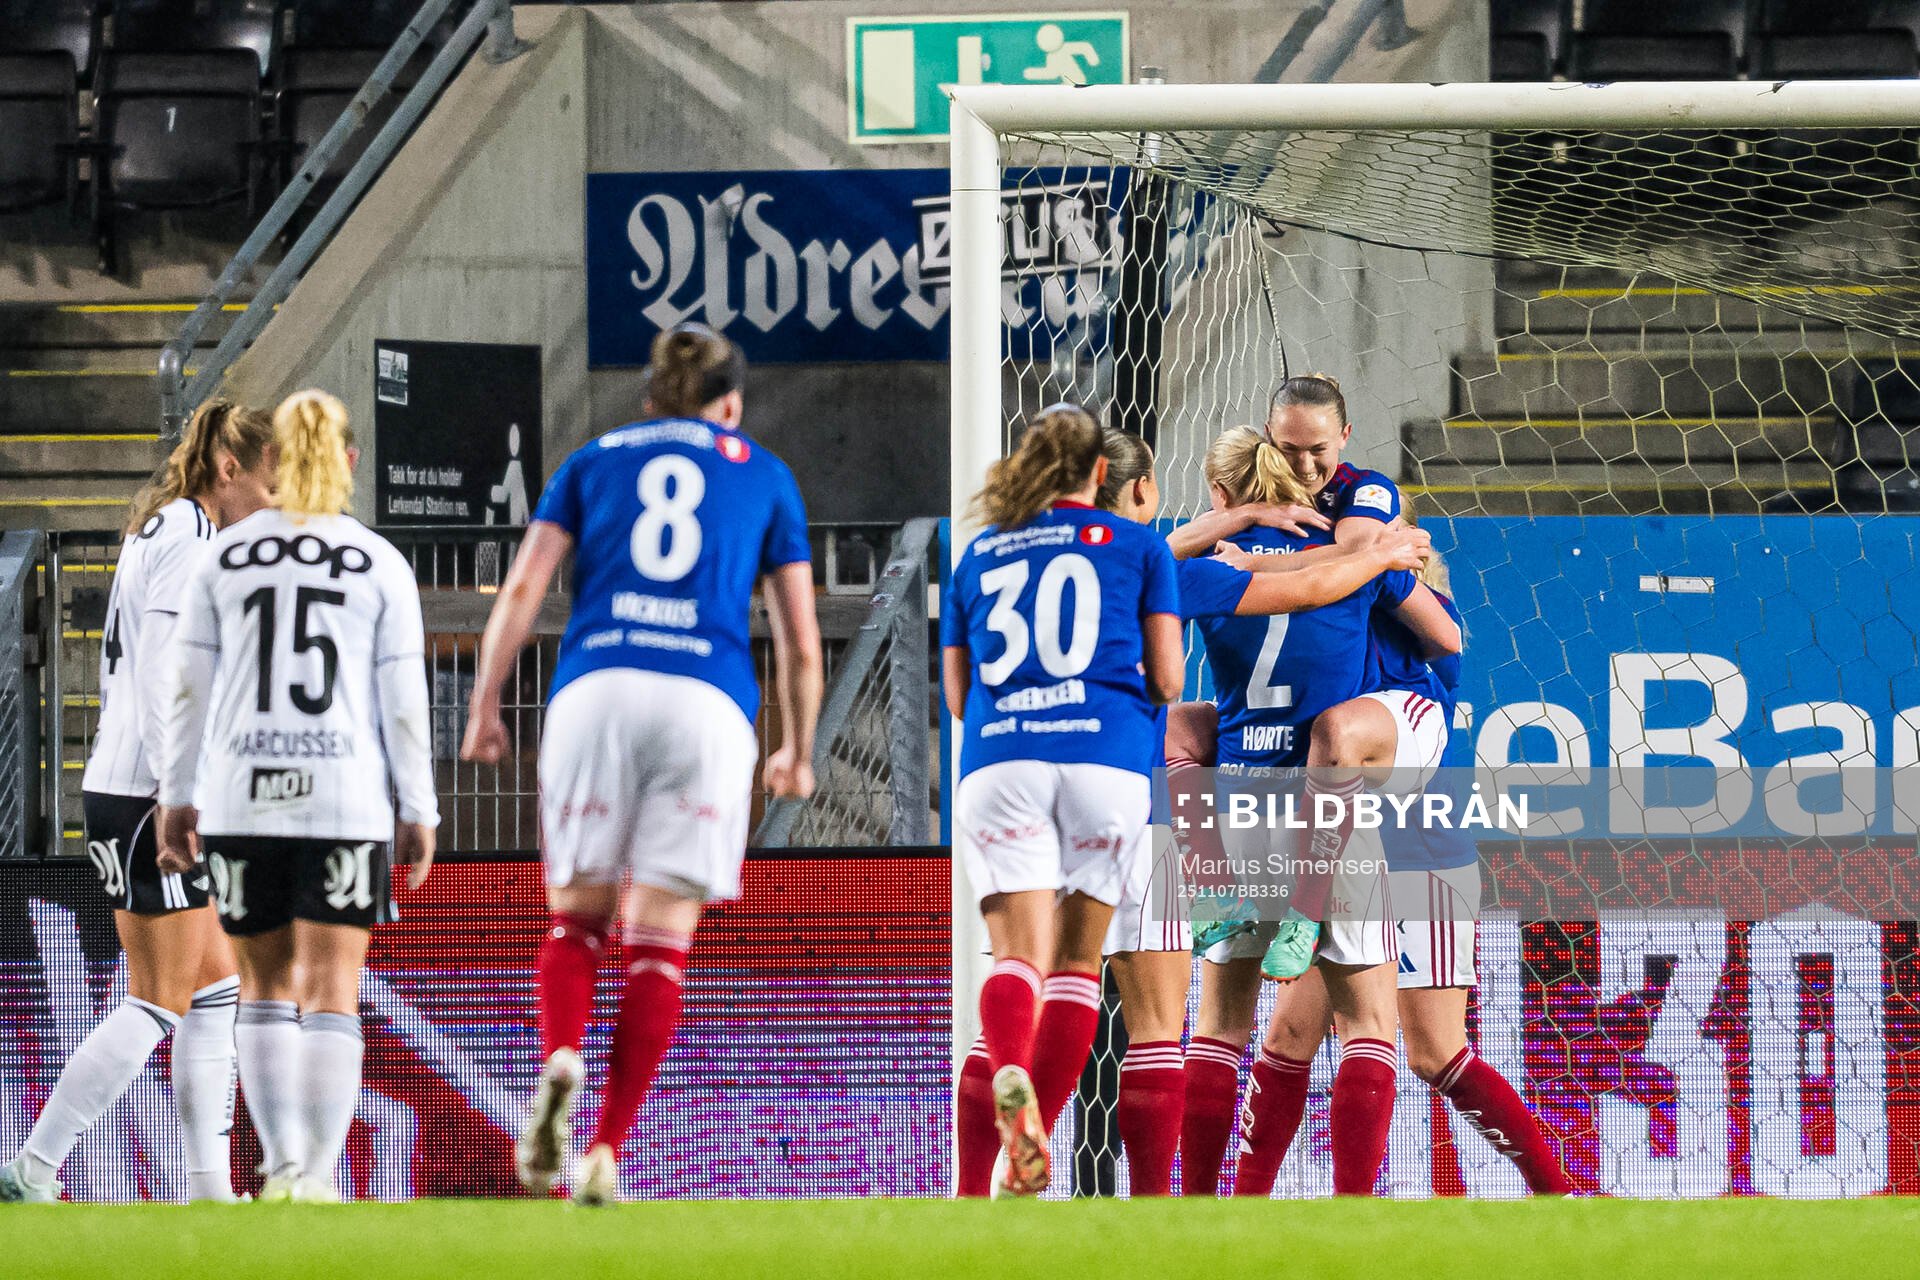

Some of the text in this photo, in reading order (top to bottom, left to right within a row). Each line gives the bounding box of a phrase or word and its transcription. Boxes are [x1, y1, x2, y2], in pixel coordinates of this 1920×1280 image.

[388, 465, 406, 484] Takk
[407, 465, 417, 485] for
[388, 494, 424, 515] Lerkendal
[426, 496, 454, 516] Stadion
[630, 453, 706, 582] 8
[220, 535, 371, 578] coop
[979, 552, 1100, 686] 30
[243, 586, 346, 716] 15
[1242, 726, 1294, 751] HØRTE
[1218, 762, 1245, 777] mot
